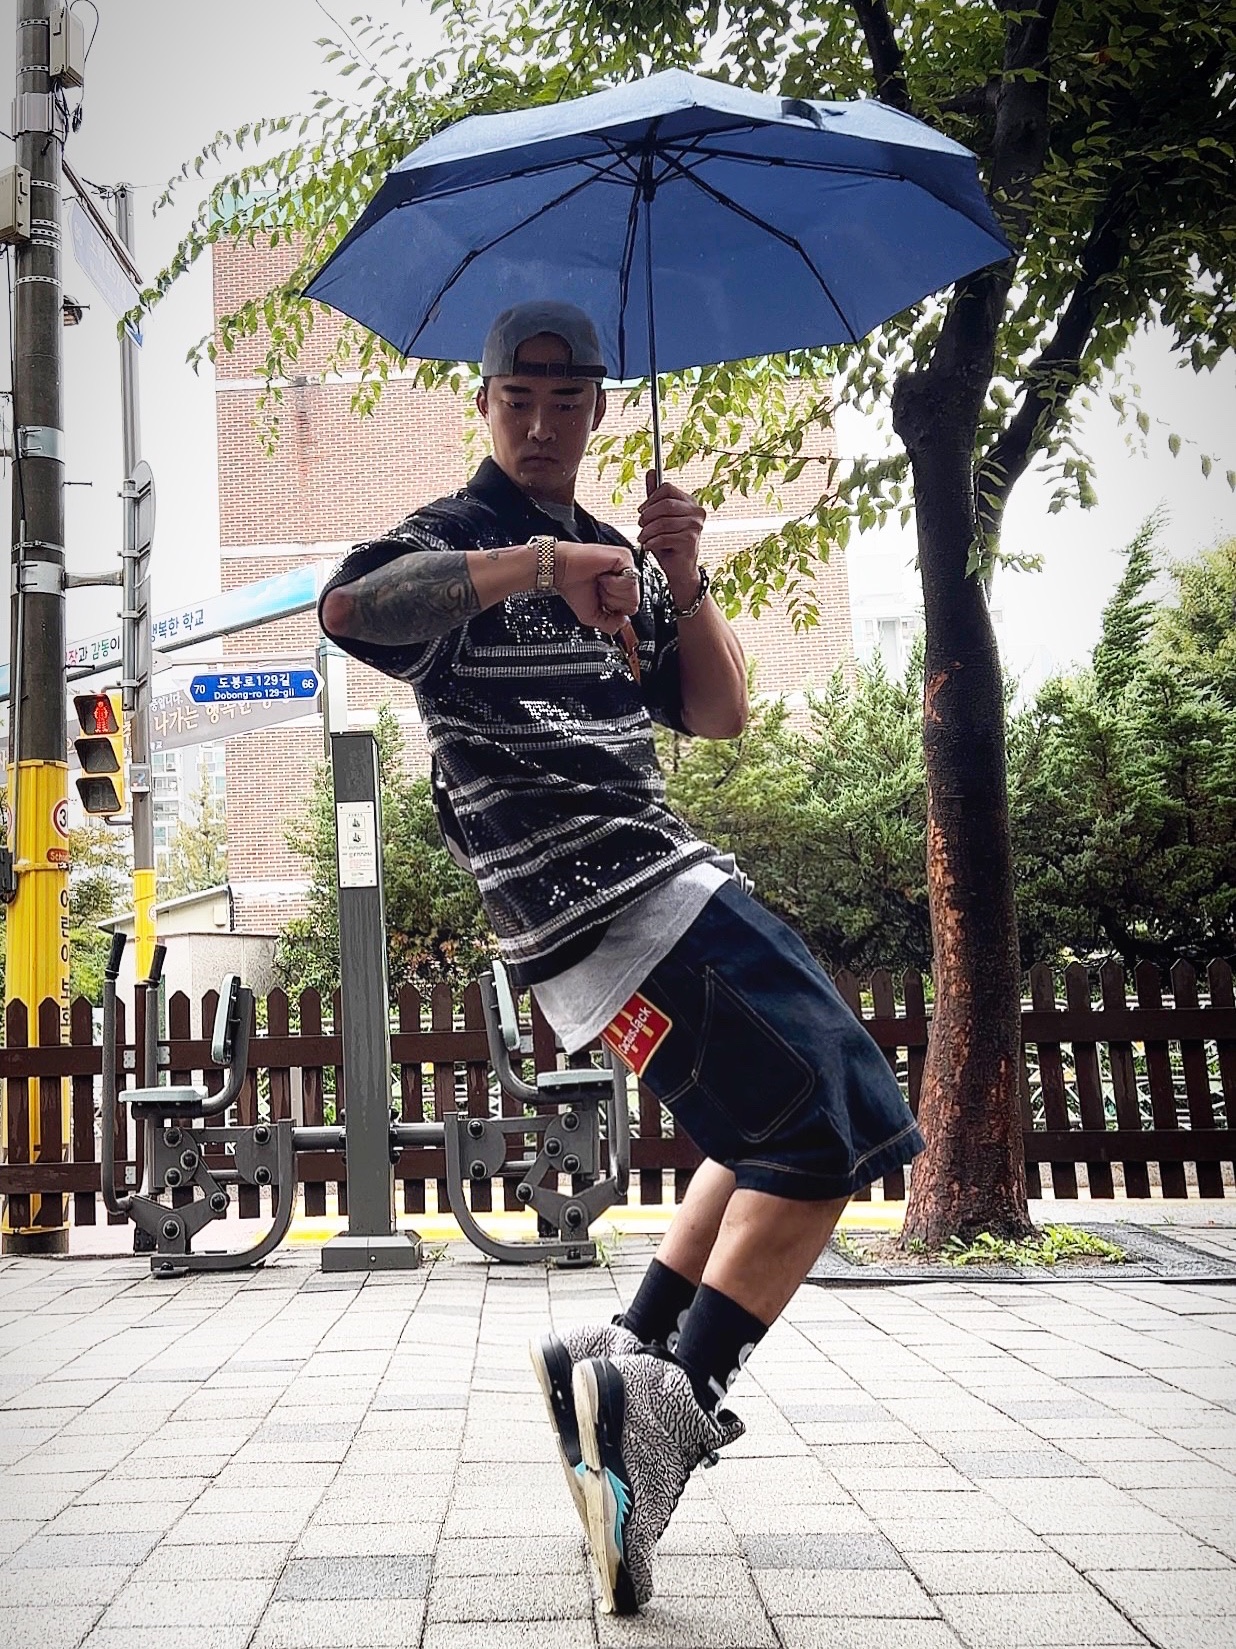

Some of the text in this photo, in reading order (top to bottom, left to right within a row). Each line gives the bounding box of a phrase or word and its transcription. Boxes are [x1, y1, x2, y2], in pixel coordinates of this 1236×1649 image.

[182, 608, 204, 631] 학교
[91, 635, 120, 660] 감동이
[193, 684, 206, 695] 70
[217, 673, 291, 690] 도봉로129길
[301, 678, 315, 690] 66
[213, 687, 295, 701] Dobong-ro 129-gil
[153, 705, 200, 738] 나가는
